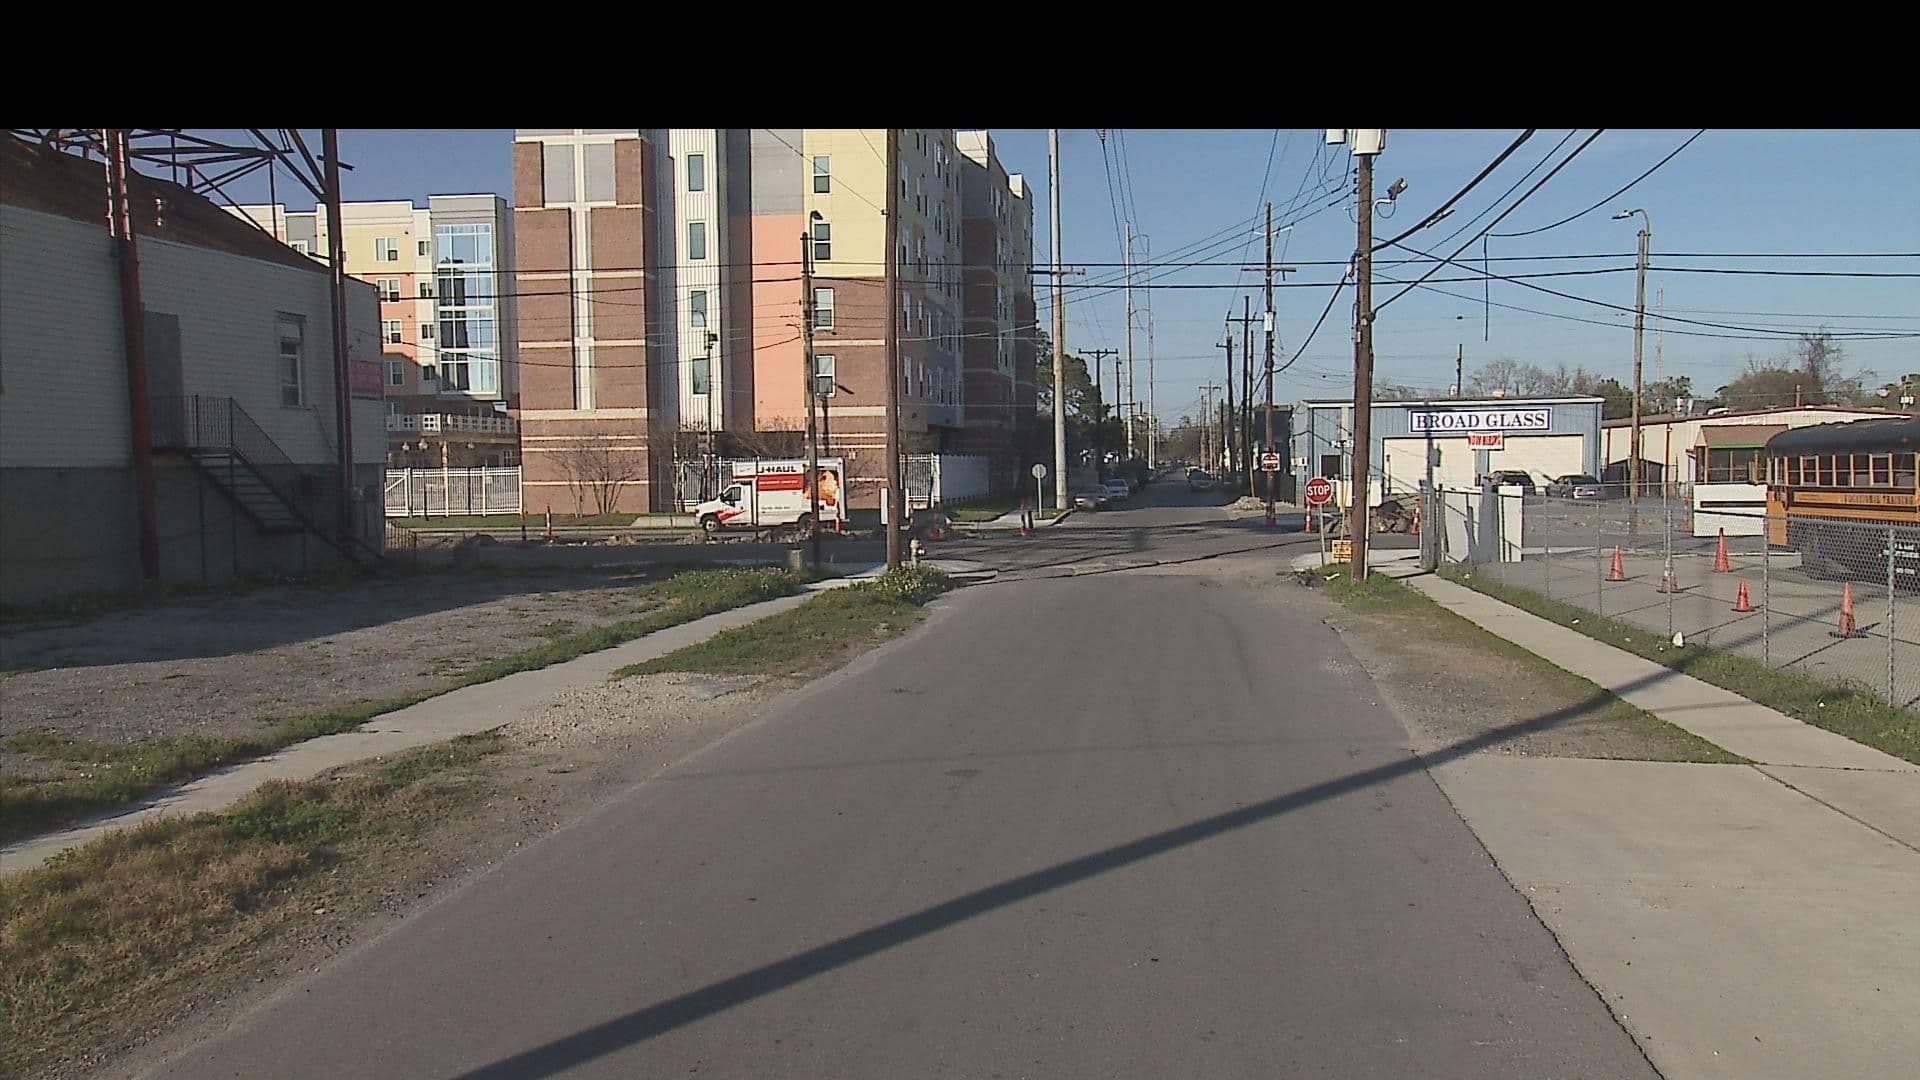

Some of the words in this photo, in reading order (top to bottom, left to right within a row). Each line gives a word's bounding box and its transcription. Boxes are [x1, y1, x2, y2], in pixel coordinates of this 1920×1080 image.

[1416, 414, 1479, 429] BROAD
[1486, 412, 1545, 427] GLASS
[1307, 484, 1330, 496] STOP
[1882, 495, 1914, 505] TRAINING
